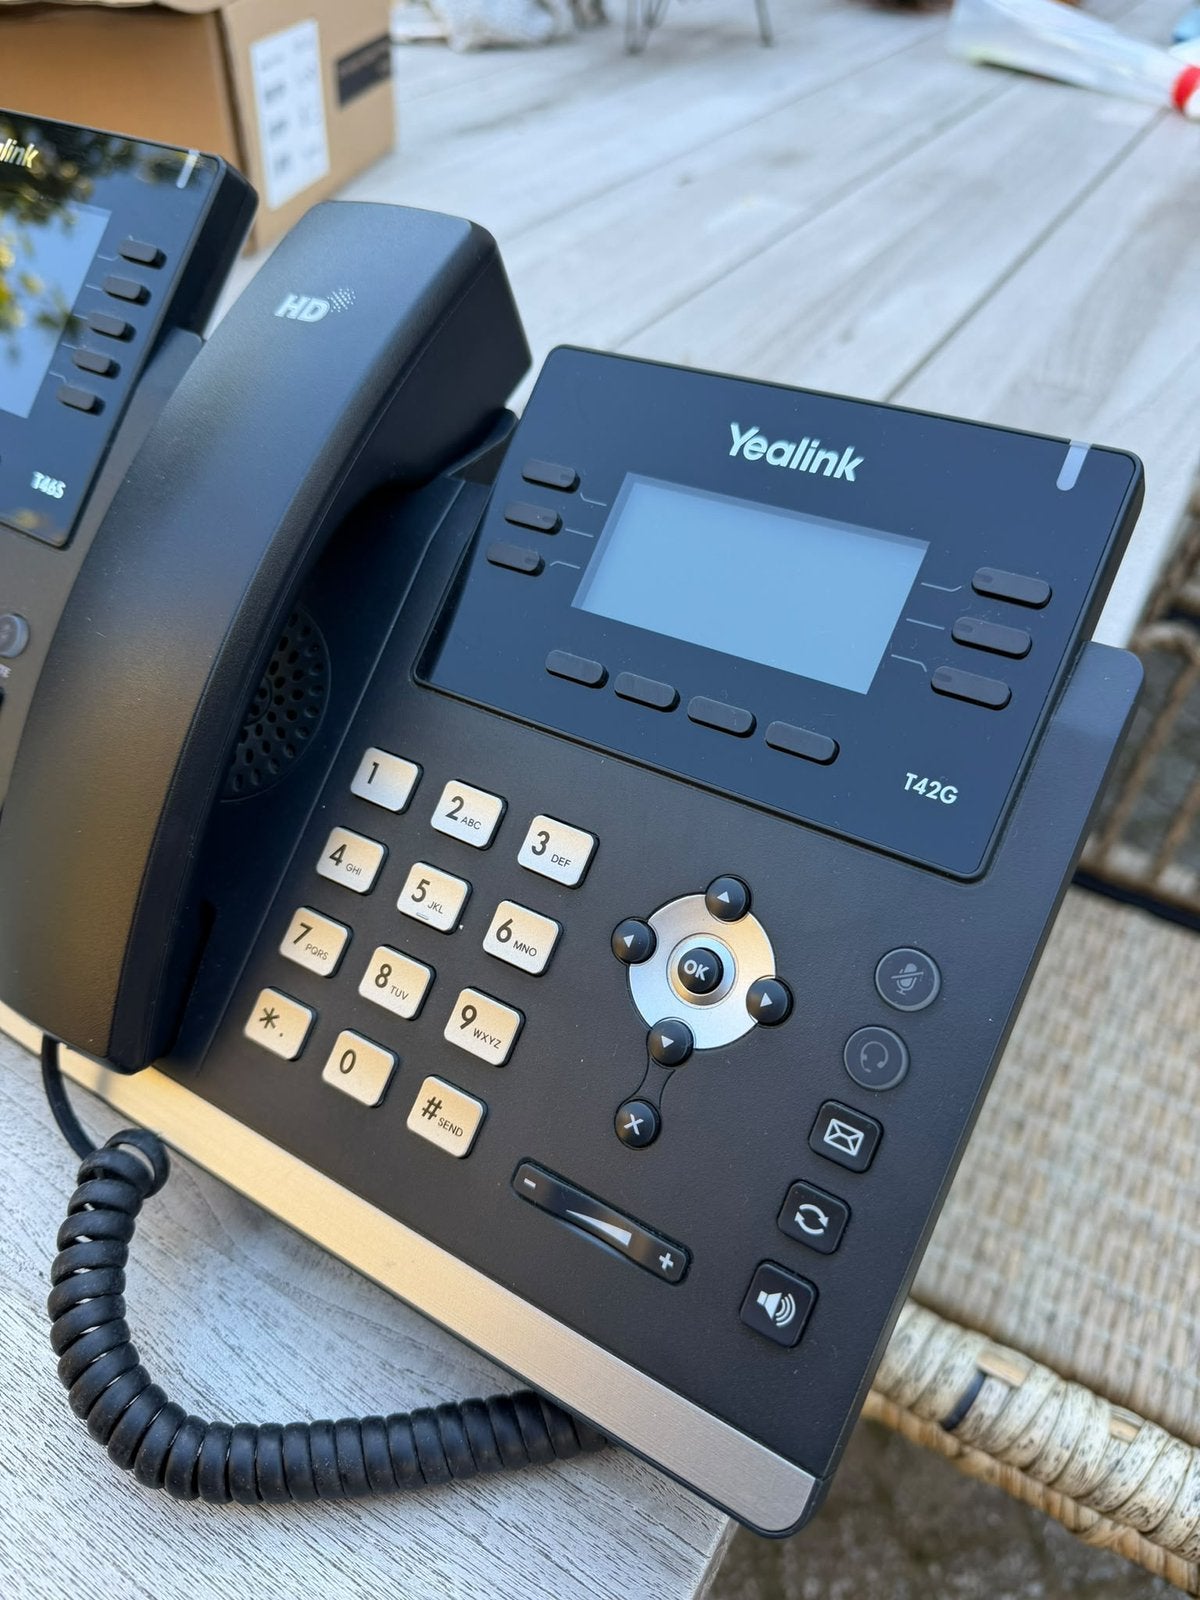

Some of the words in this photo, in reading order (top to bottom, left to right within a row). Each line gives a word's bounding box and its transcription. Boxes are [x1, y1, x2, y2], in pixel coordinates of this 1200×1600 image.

[274, 293, 331, 323] HD
[729, 422, 864, 482] Yealink
[367, 761, 380, 785] 1
[904, 772, 959, 804] T42G
[444, 795, 467, 822] 2
[460, 816, 482, 830] ABC
[328, 843, 347, 866] 4
[345, 863, 362, 876] GHI
[531, 830, 551, 856] 3
[550, 853, 572, 868] DEF
[410, 878, 431, 903] 5
[427, 901, 443, 915] JKL
[292, 922, 313, 945] 7
[304, 943, 329, 961] PQRS
[495, 918, 514, 944] 6
[512, 940, 538, 957] MNO
[374, 963, 393, 989] 8
[390, 984, 409, 1001] TUV
[683, 959, 710, 981] OK
[459, 1004, 478, 1030] 9
[473, 1027, 502, 1050] WXYZ
[339, 1049, 357, 1075] 0
[437, 1117, 464, 1137] SEND
